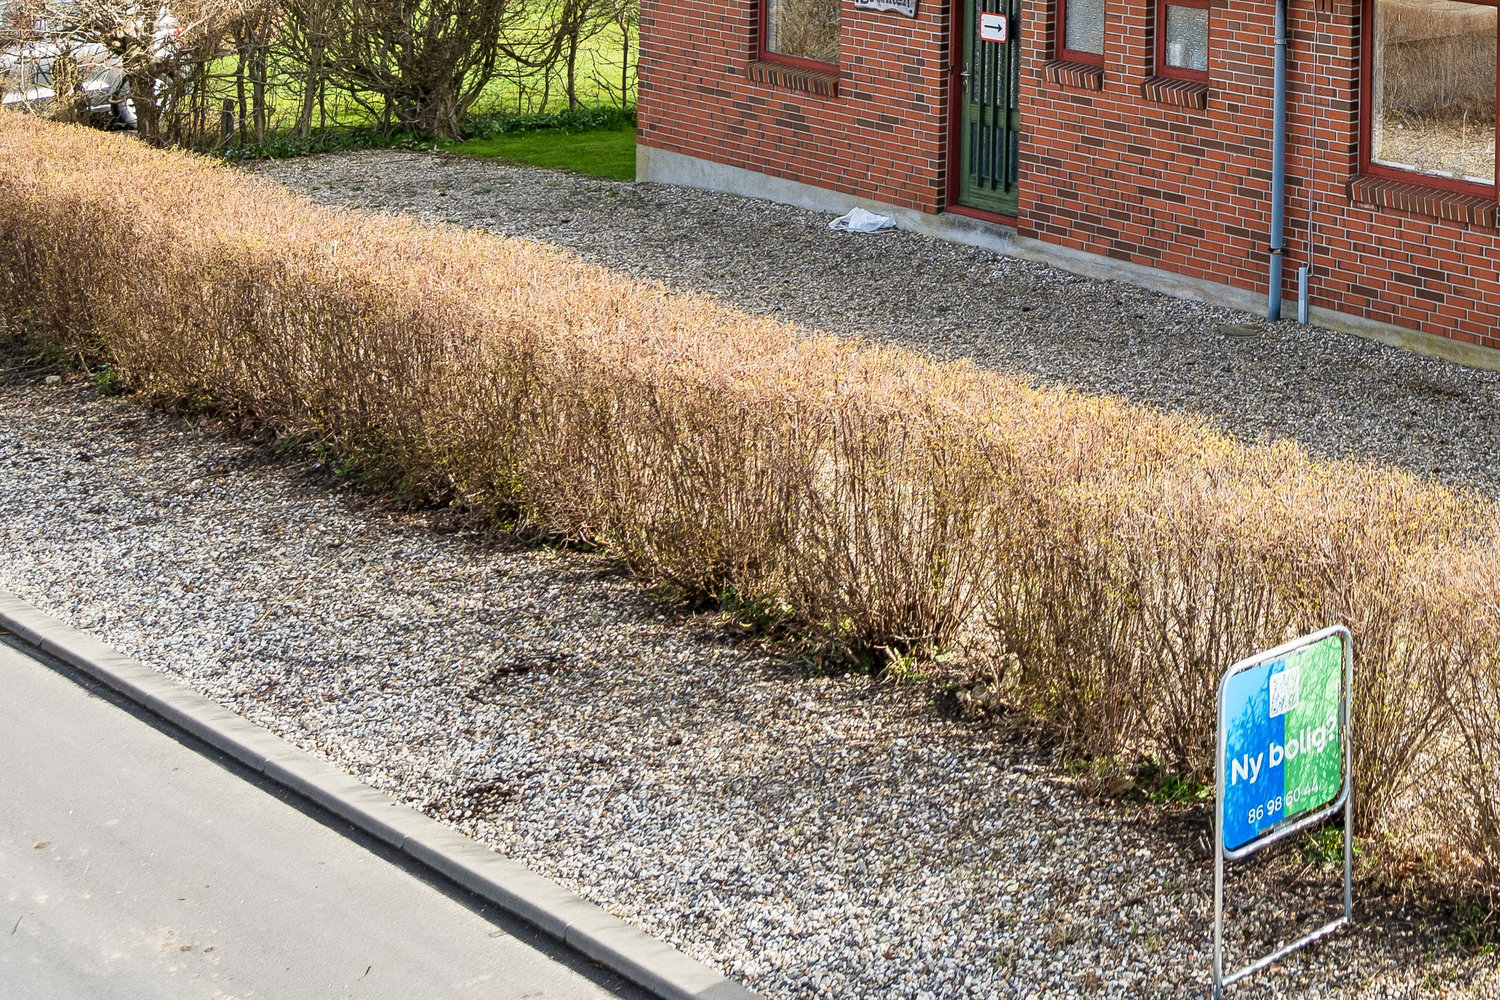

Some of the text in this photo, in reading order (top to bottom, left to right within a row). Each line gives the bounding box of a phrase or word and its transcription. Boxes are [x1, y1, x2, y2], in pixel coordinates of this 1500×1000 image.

[1231, 714, 1337, 786] Ny bolig?
[1248, 804, 1264, 824] 86
[1267, 796, 1282, 815] 98
[1286, 787, 1301, 806] 60
